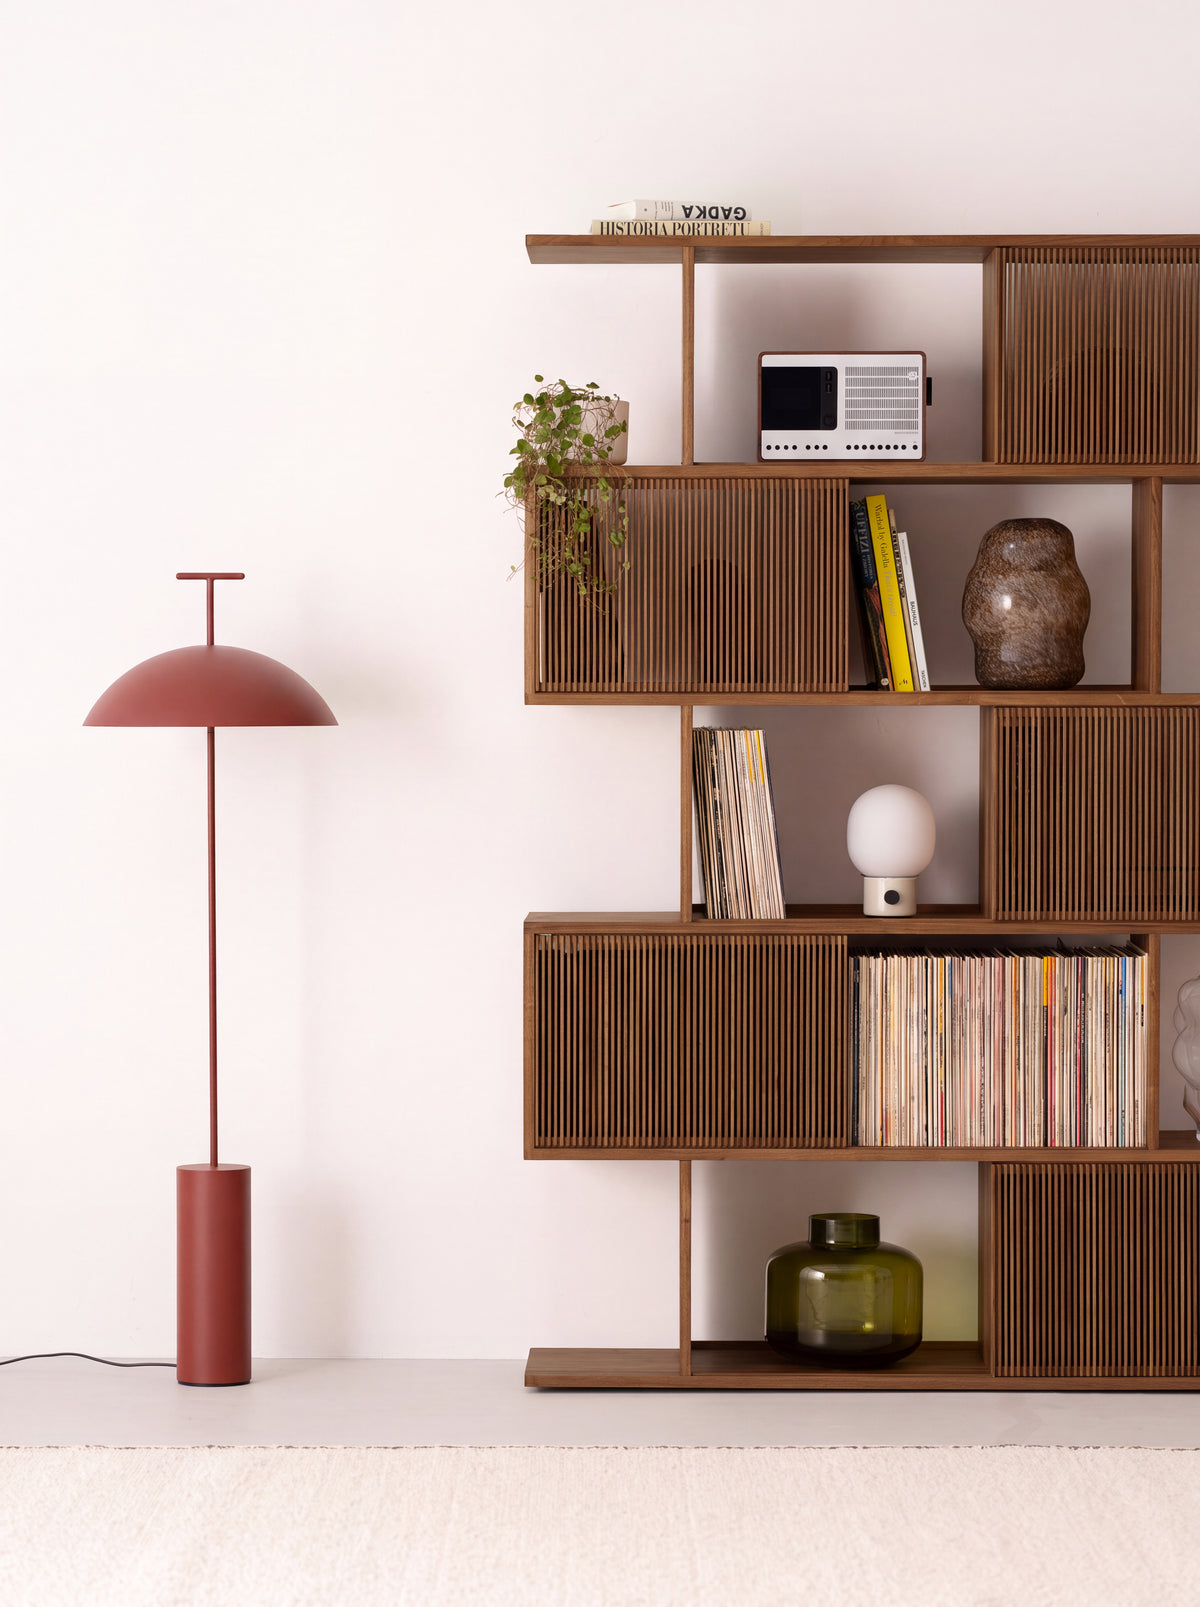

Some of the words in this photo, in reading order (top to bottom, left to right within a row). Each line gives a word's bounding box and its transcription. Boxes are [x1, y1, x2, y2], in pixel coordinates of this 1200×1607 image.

[681, 204, 747, 221] GADKA
[600, 221, 668, 236] HISTORIA
[673, 222, 750, 236] PORTRETU
[856, 512, 869, 552] UFFIZI
[874, 504, 884, 532] Warhol
[880, 542, 889, 568] Galella
[910, 601, 918, 626] BAUHAUS
